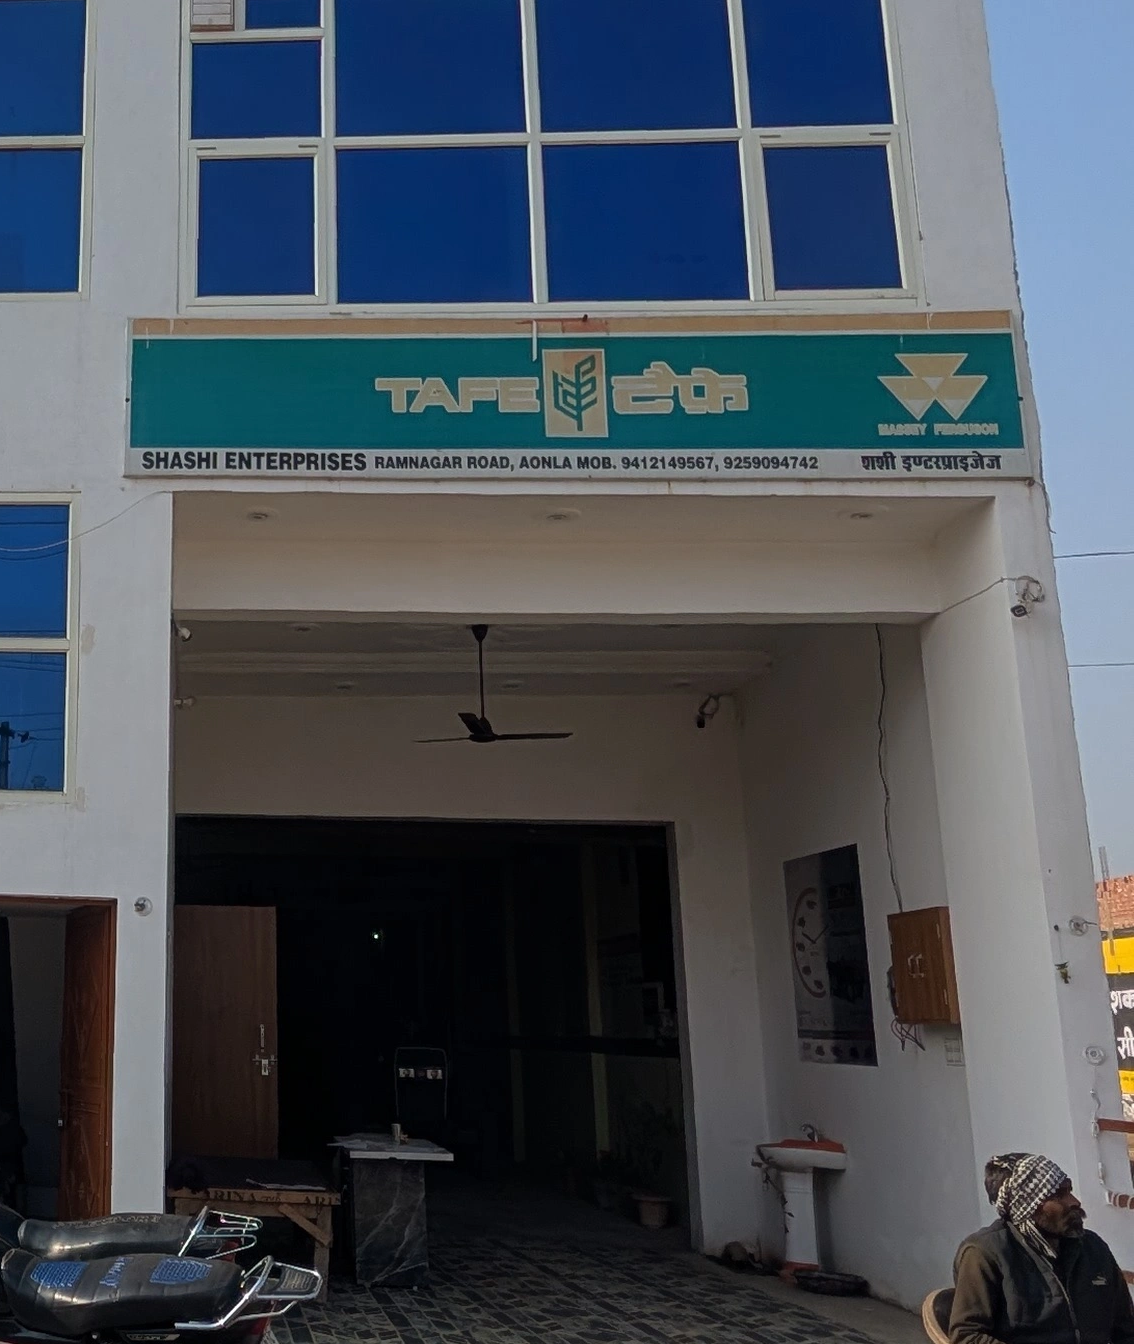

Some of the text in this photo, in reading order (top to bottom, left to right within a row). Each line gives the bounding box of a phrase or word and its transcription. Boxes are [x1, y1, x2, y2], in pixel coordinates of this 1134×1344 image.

[374, 376, 541, 413] TAFE
[141, 451, 819, 472] SHASHI ENTERPRISES RAMNAGAR ROAD, AONLA MOB. 9412149567, 9259094742
[861, 451, 896, 470] शशी
